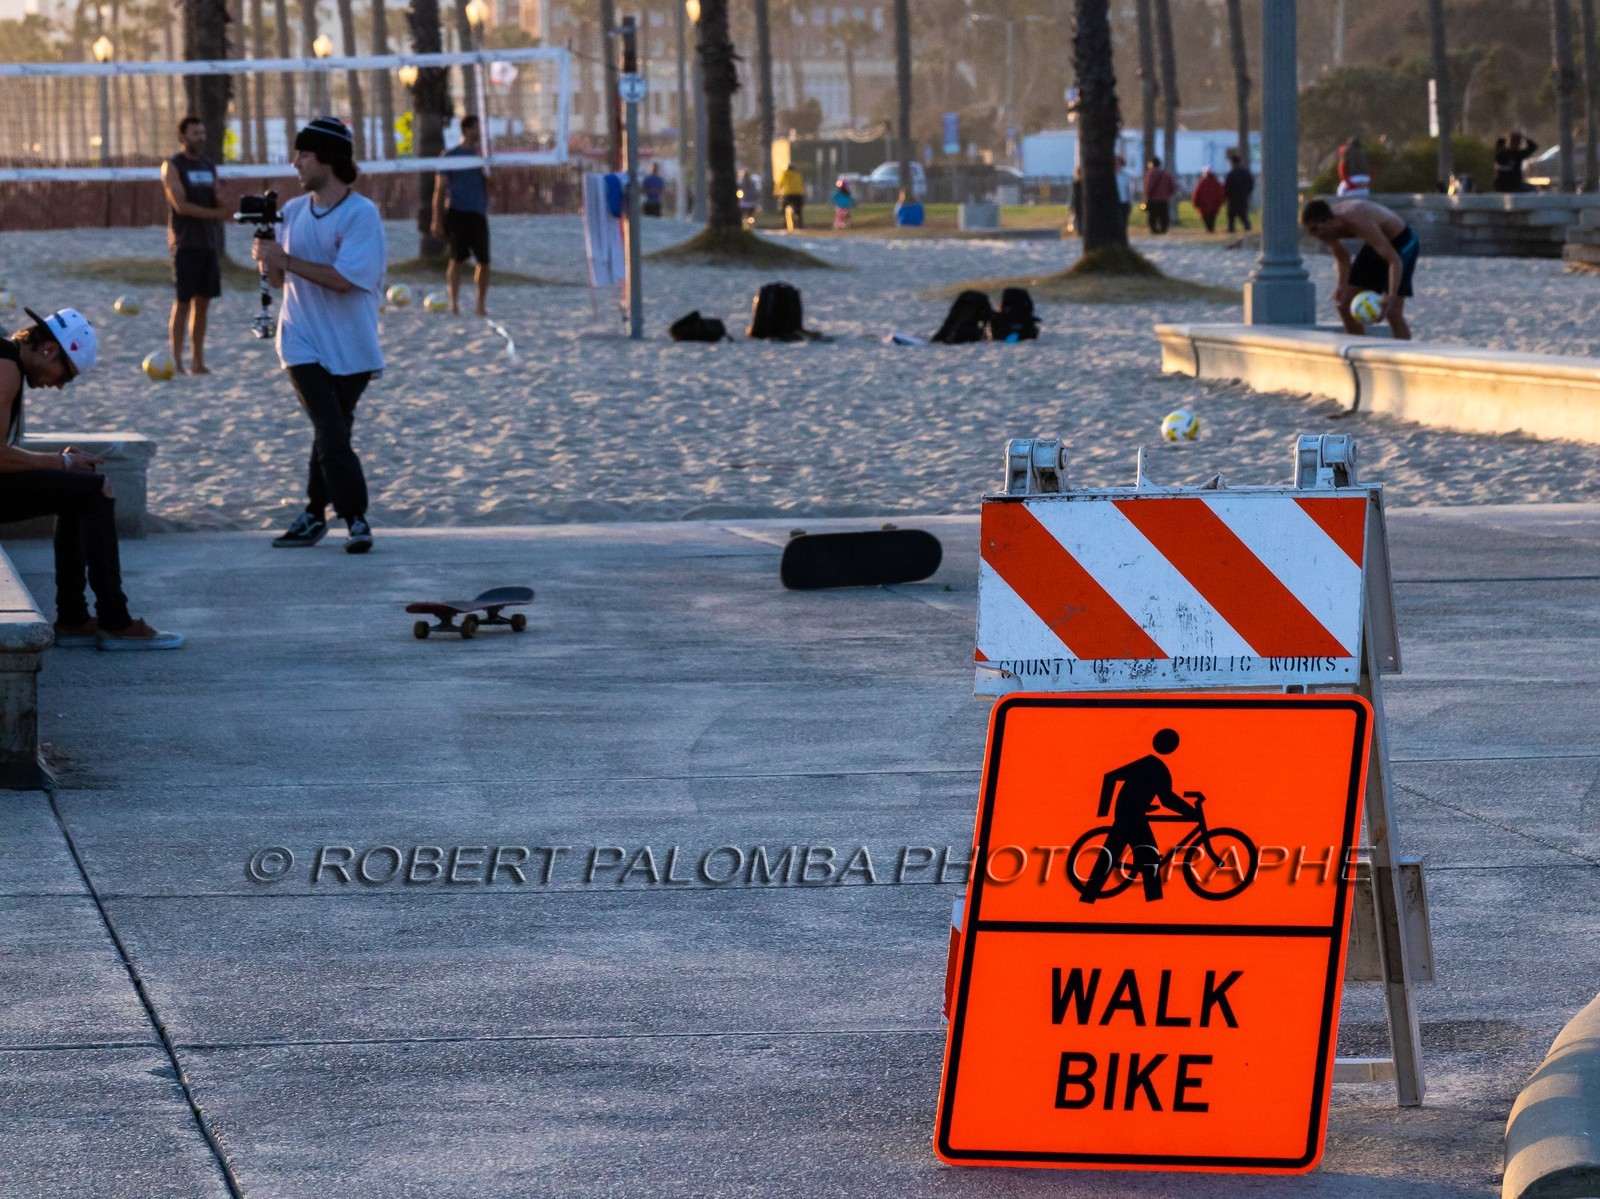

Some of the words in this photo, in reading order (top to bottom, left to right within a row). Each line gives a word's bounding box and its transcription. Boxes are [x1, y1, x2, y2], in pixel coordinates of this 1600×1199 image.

[1000, 658, 1076, 679] COUNTY
[1173, 655, 1251, 673] PUBLIC
[1269, 655, 1337, 673] WORKS
[1051, 967, 1244, 1029] WALK
[1054, 1051, 1213, 1113] BIKE
